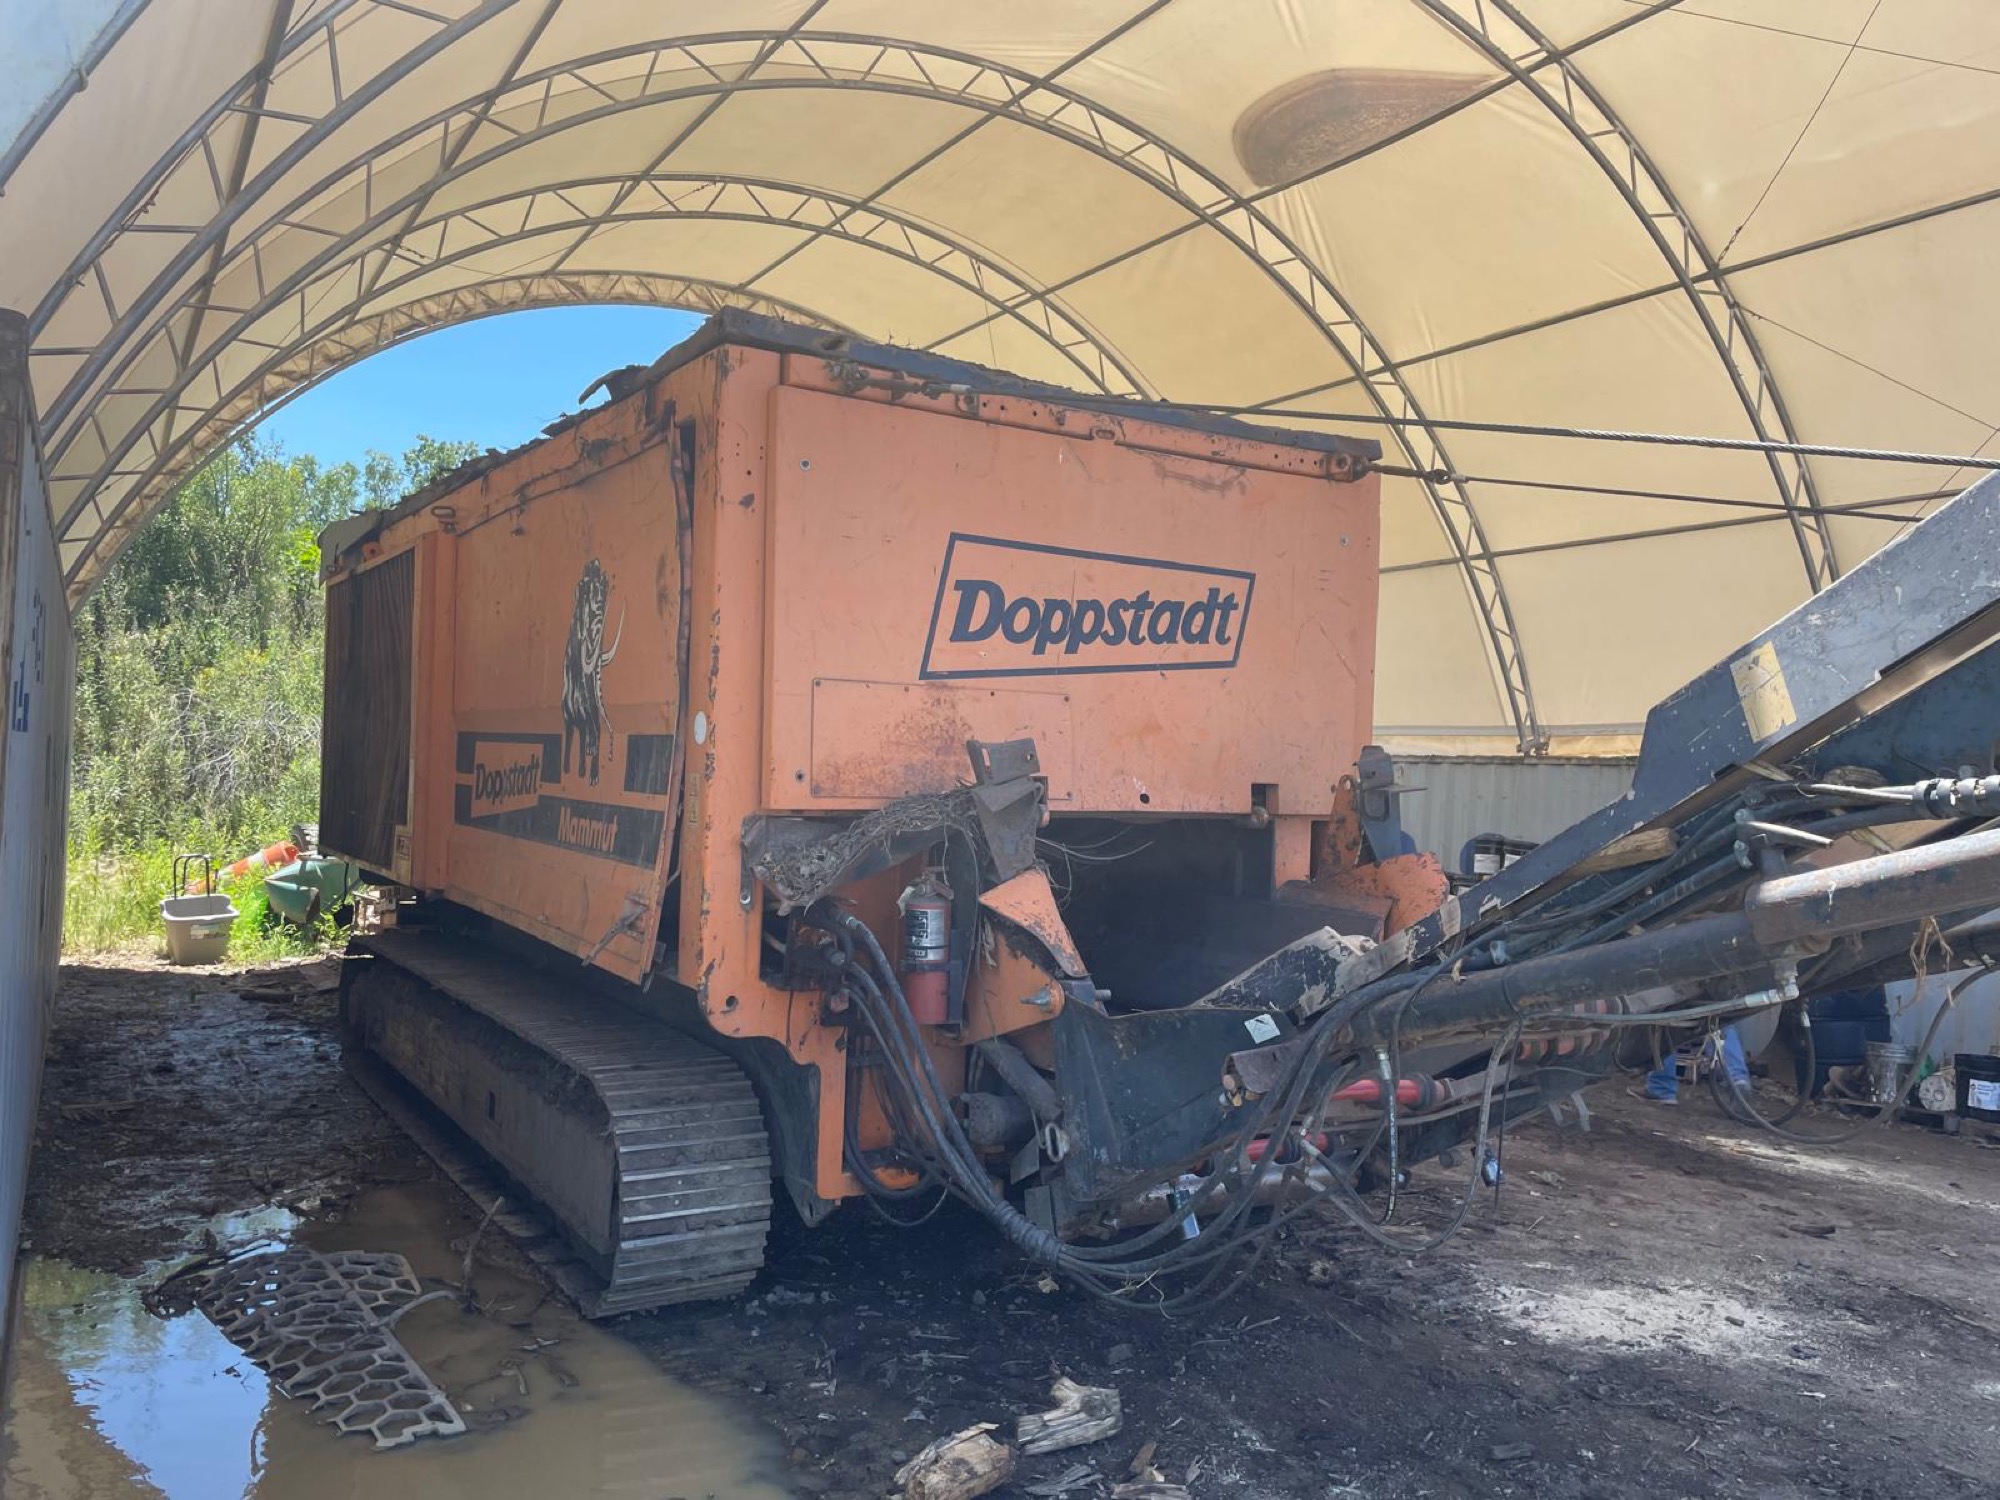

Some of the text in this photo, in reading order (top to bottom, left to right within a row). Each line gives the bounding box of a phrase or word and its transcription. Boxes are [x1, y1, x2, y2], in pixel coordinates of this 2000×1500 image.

[949, 579, 1239, 655] Doppstadt
[475, 754, 541, 805] Doppstadt
[558, 805, 618, 852] Mammut
